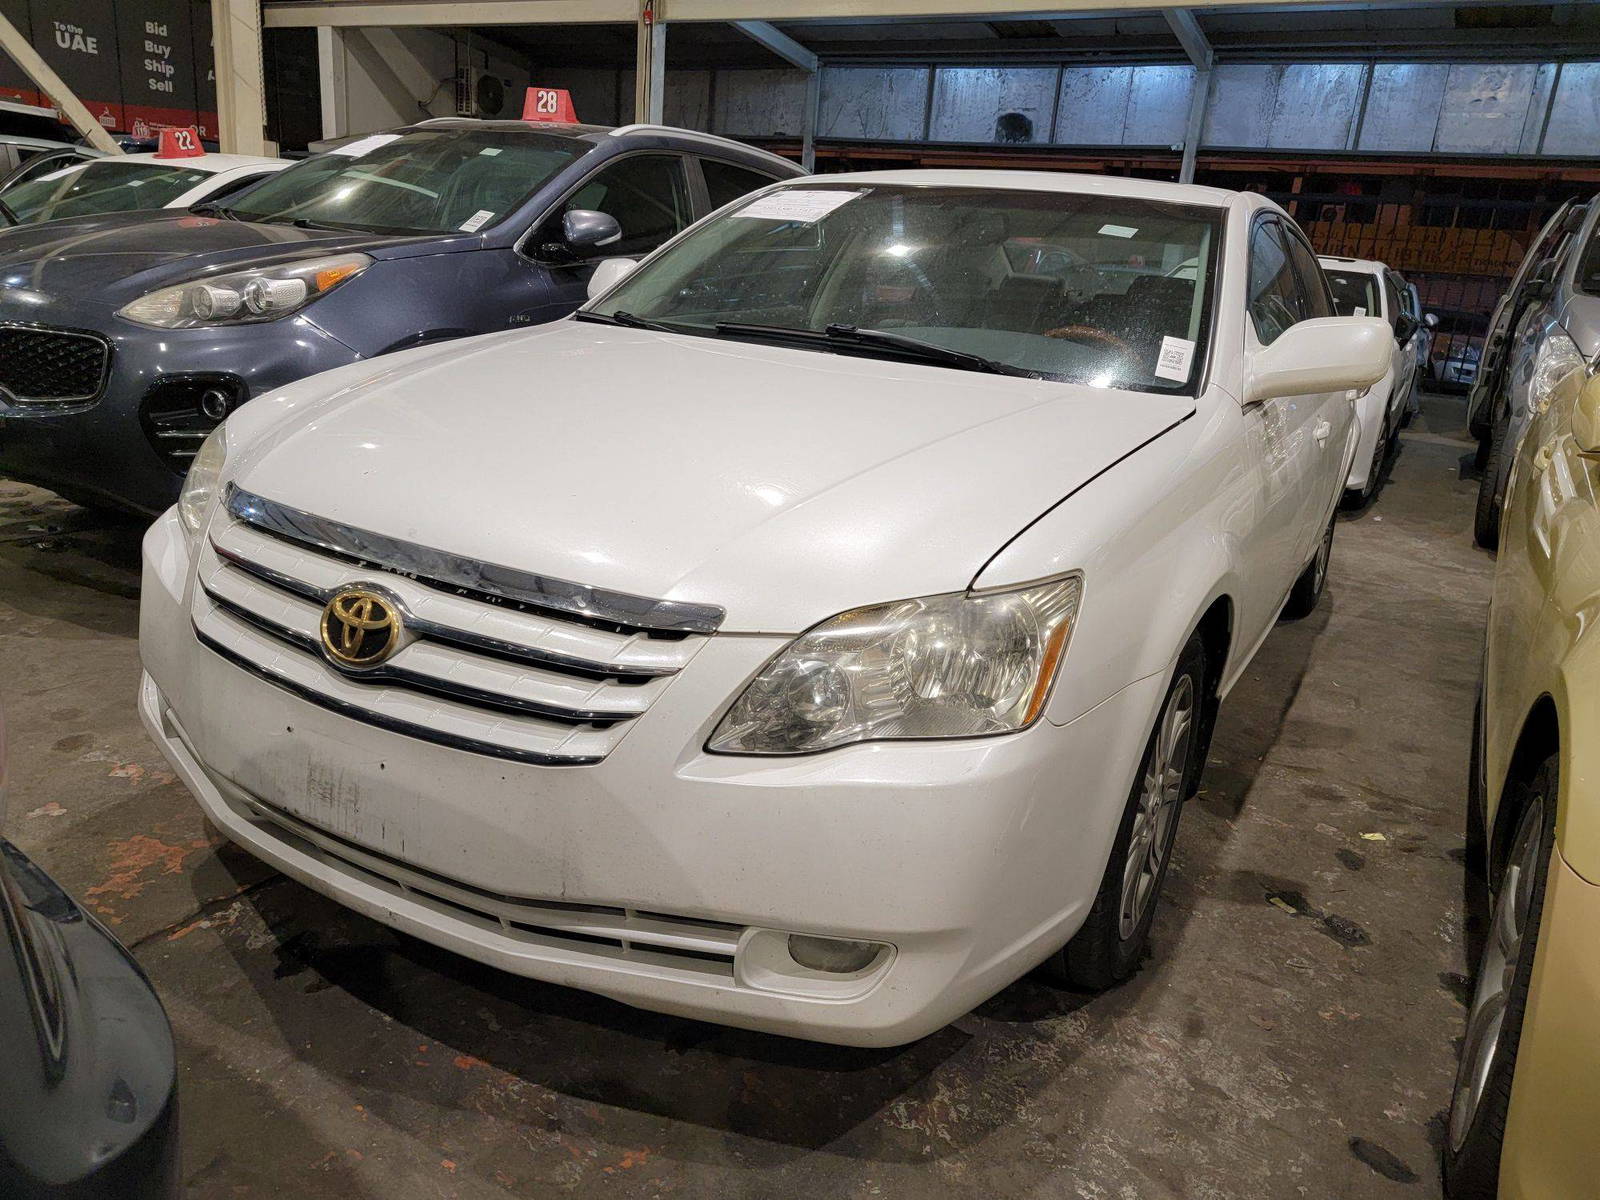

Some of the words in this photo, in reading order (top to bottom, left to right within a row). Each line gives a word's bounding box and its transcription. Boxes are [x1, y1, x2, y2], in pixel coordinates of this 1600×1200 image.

[54, 21, 66, 31] To
[67, 23, 83, 35] the
[145, 21, 168, 37] Bid
[55, 30, 98, 54] UAE
[144, 40, 171, 59] Buy
[144, 59, 175, 78] Ship
[148, 78, 174, 93] Sell
[537, 90, 558, 113] 28
[174, 131, 196, 150] 22
